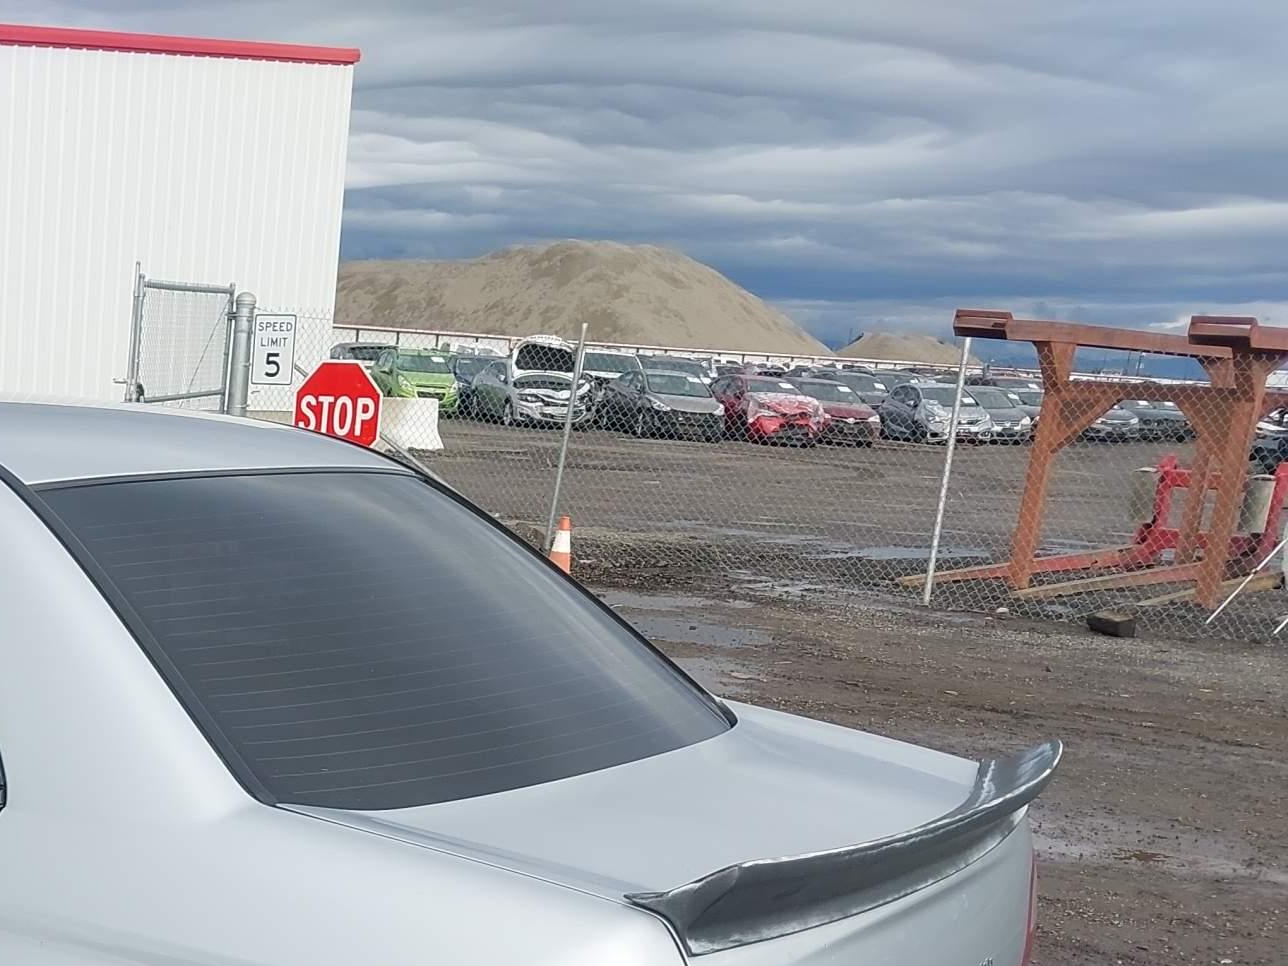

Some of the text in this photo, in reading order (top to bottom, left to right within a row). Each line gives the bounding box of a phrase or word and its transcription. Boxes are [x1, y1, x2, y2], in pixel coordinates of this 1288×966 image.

[258, 321, 293, 332] SPEED
[260, 337, 289, 348] LIMIT
[264, 352, 281, 378] 5
[298, 394, 375, 437] STOP
